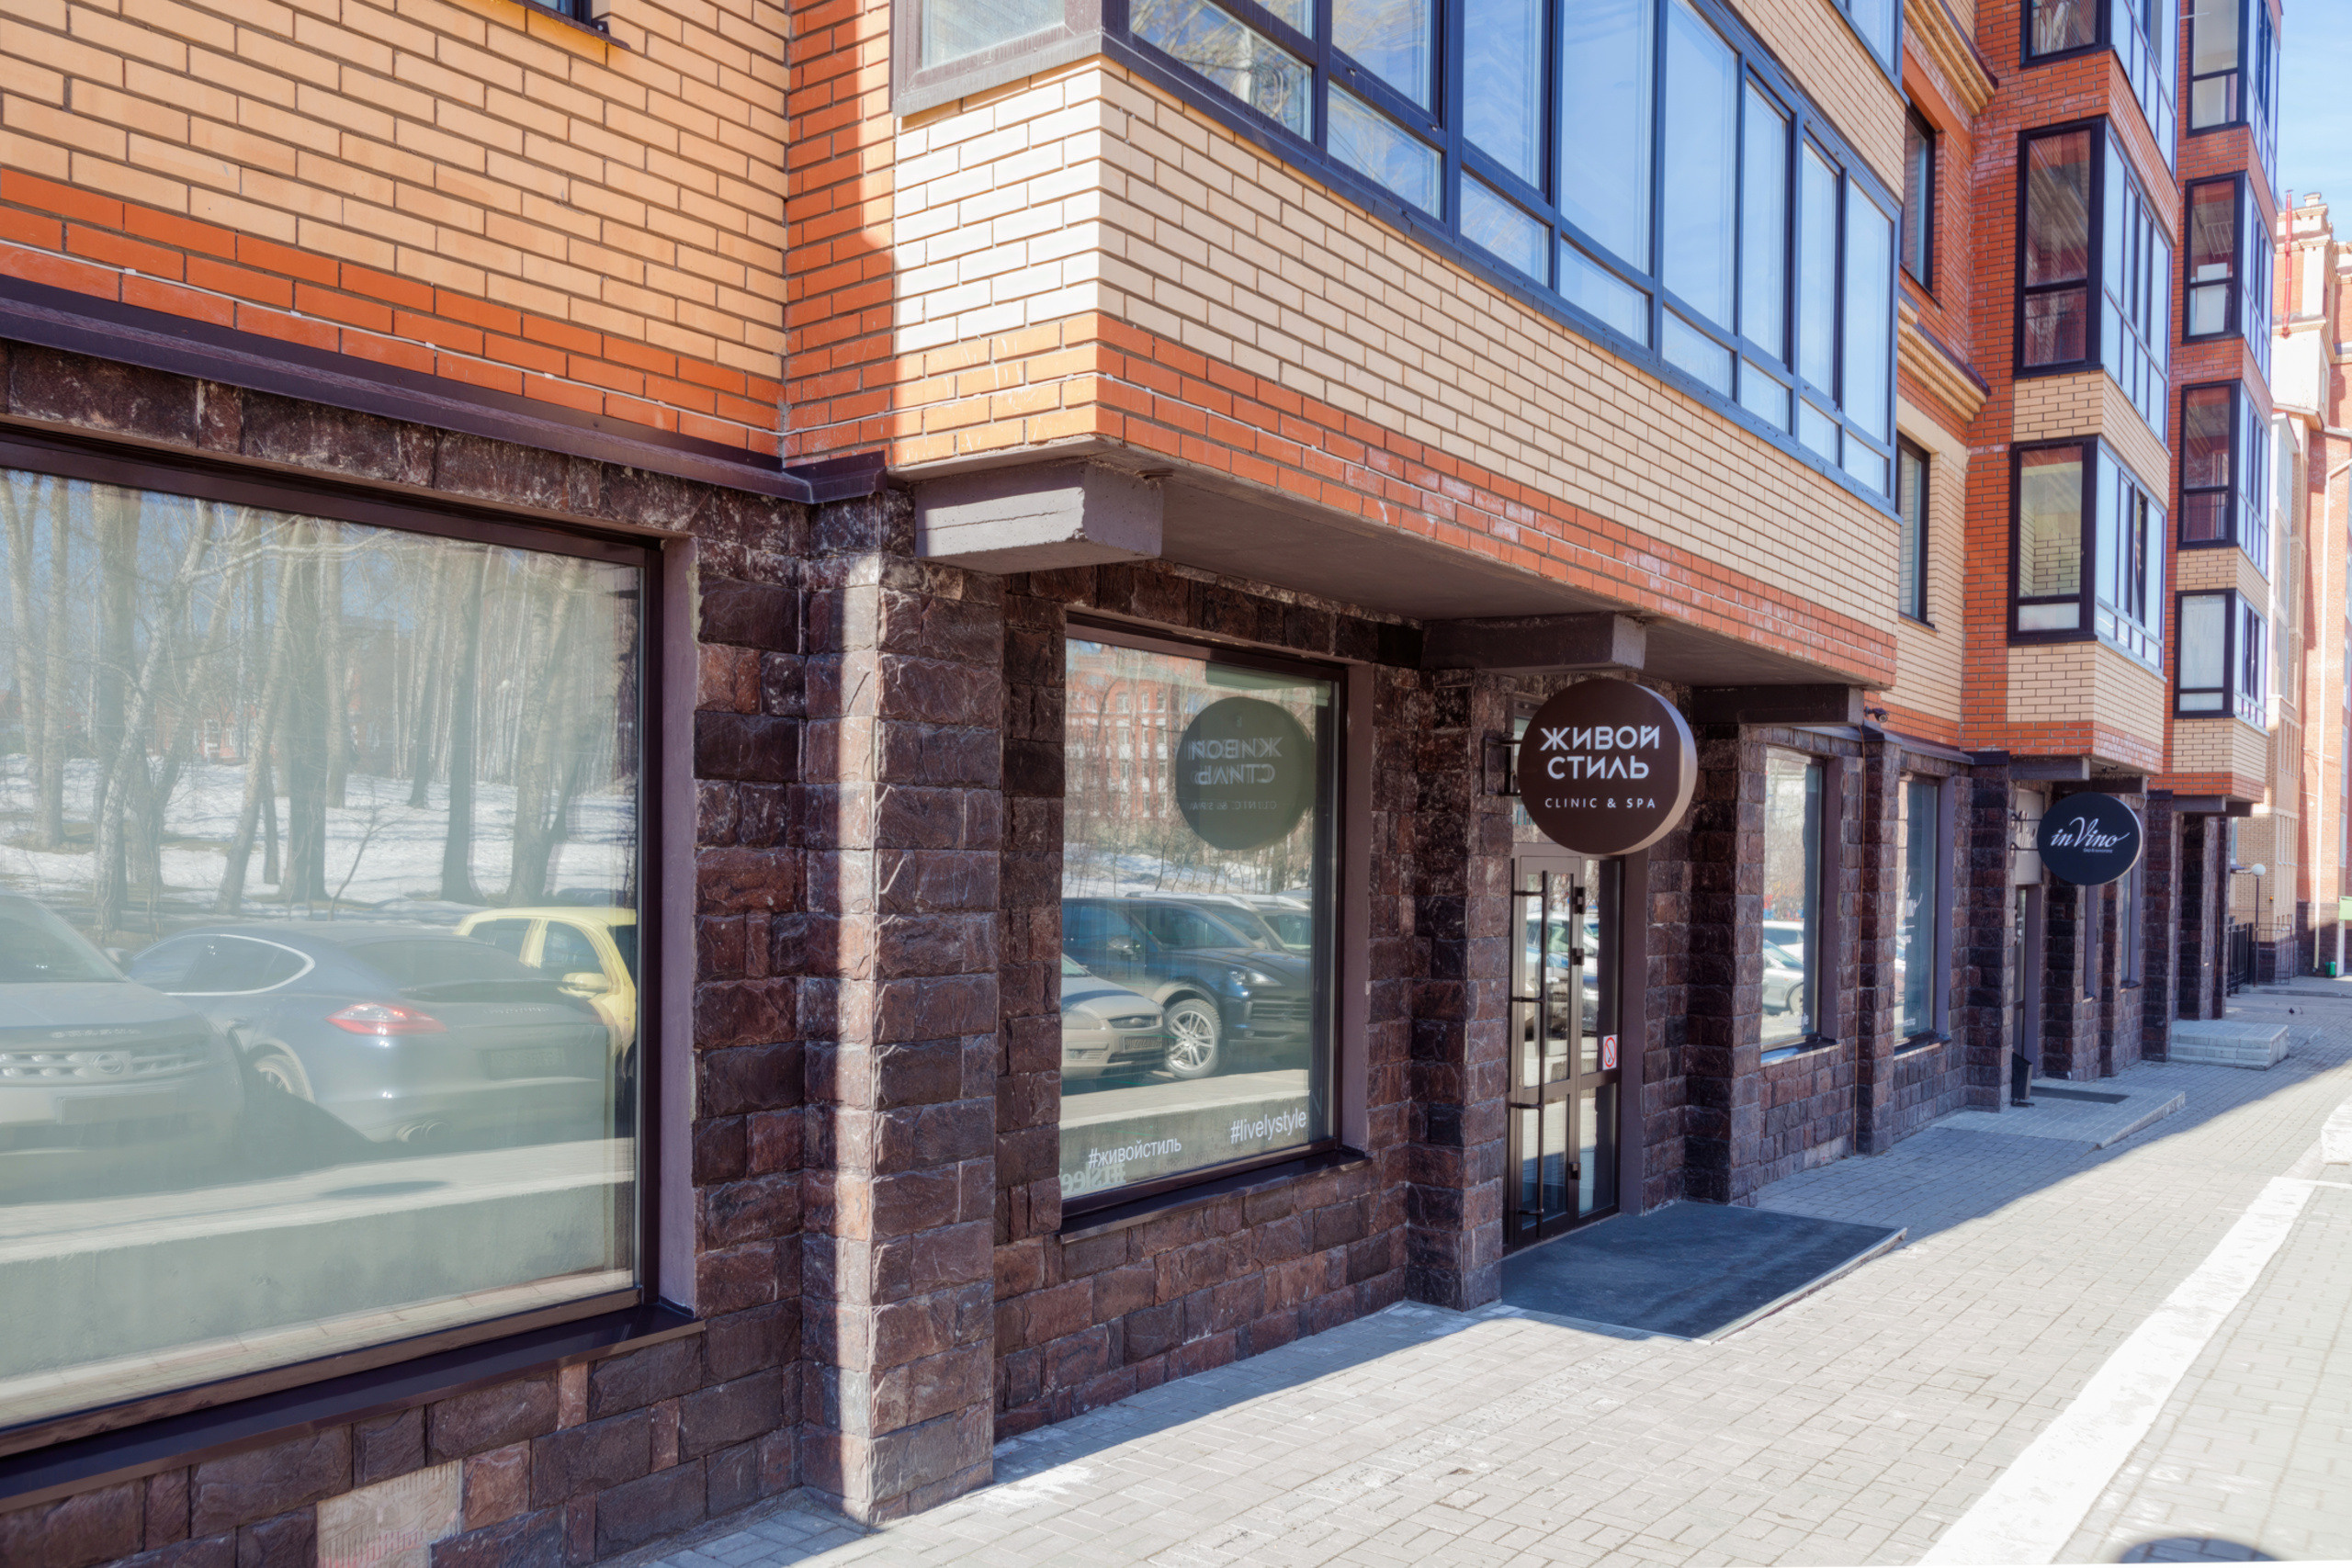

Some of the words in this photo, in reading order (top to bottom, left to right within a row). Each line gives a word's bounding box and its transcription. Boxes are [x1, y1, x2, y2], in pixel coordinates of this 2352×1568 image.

[1540, 725, 1660, 750] ЖИВОЙ
[1547, 756, 1649, 780] СТИЛЬ
[1544, 797, 1598, 809] CLINIC
[1607, 797, 1617, 809] &
[1626, 797, 1657, 809] SPA
[1230, 1107, 1306, 1144] #livelystyle
[1088, 1136, 1182, 1169] #живойстиль
